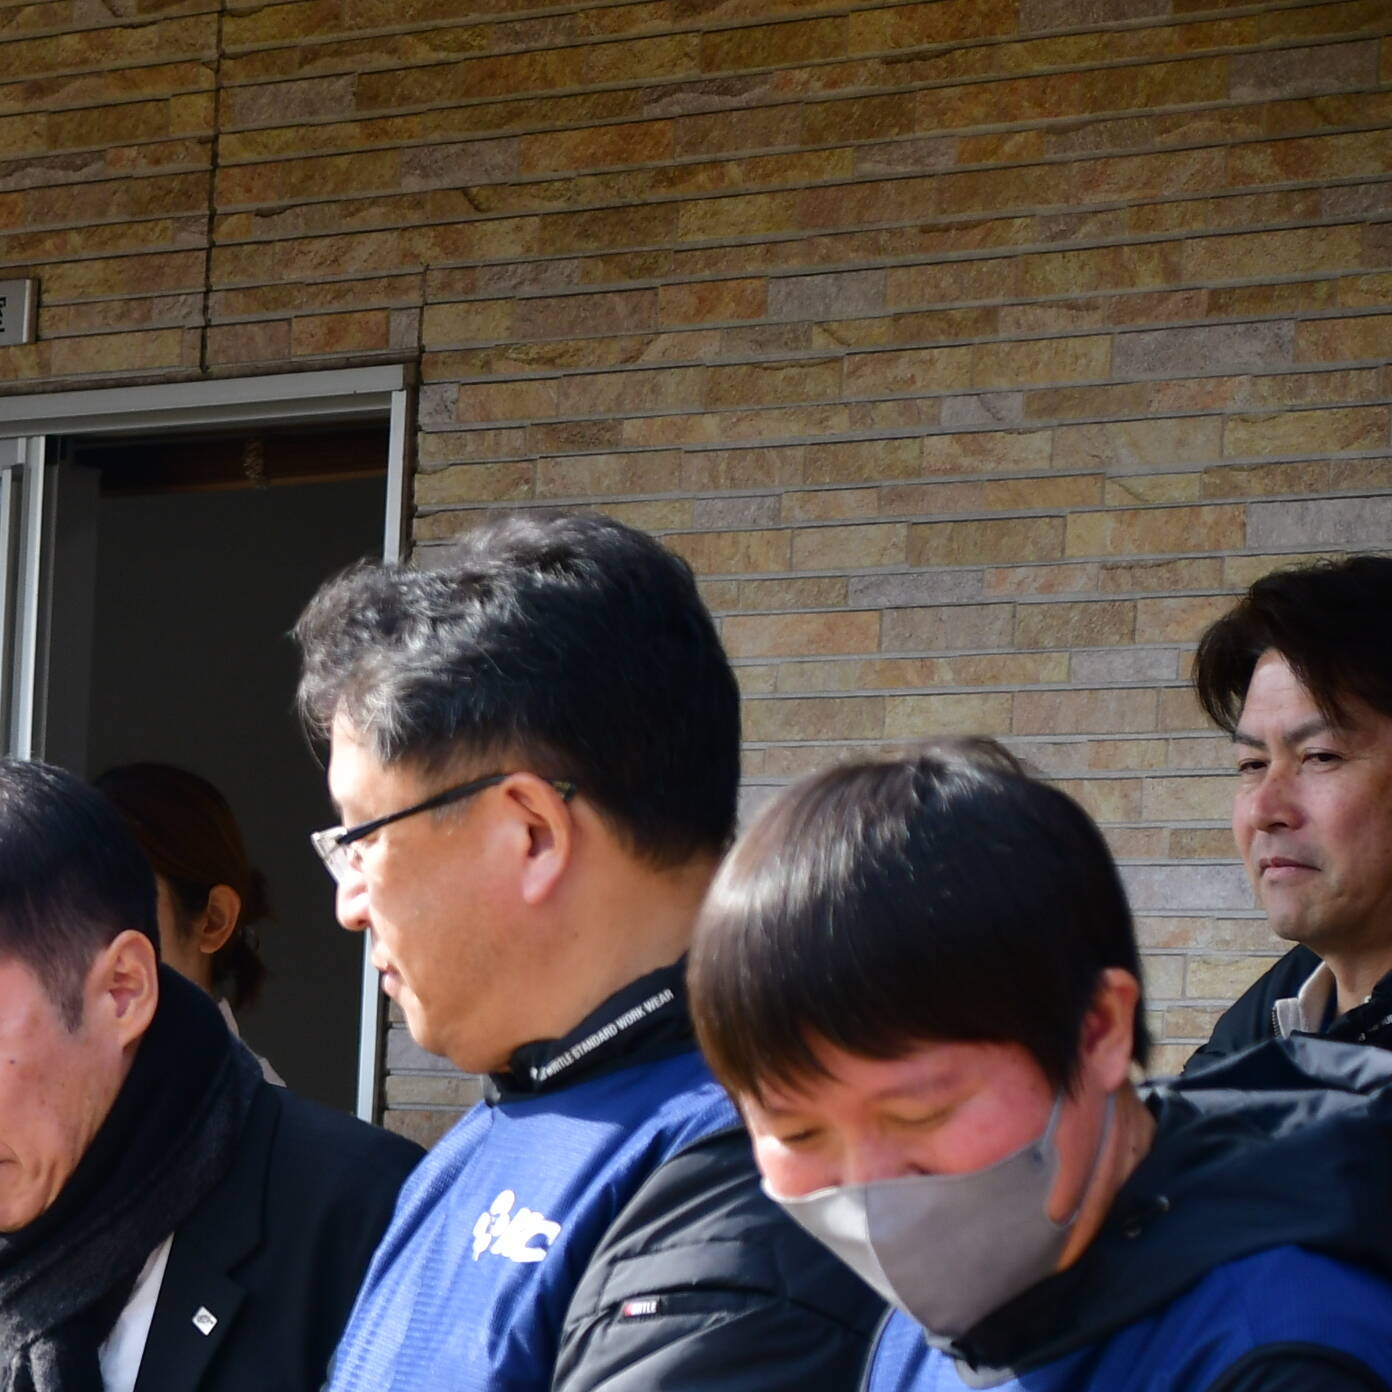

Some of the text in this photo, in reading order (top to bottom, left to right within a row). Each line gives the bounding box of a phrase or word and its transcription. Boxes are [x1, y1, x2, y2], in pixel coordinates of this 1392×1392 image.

[572, 1021, 618, 1060] STANDARD
[616, 1003, 647, 1031] WORK
[643, 987, 675, 1014] WEAR
